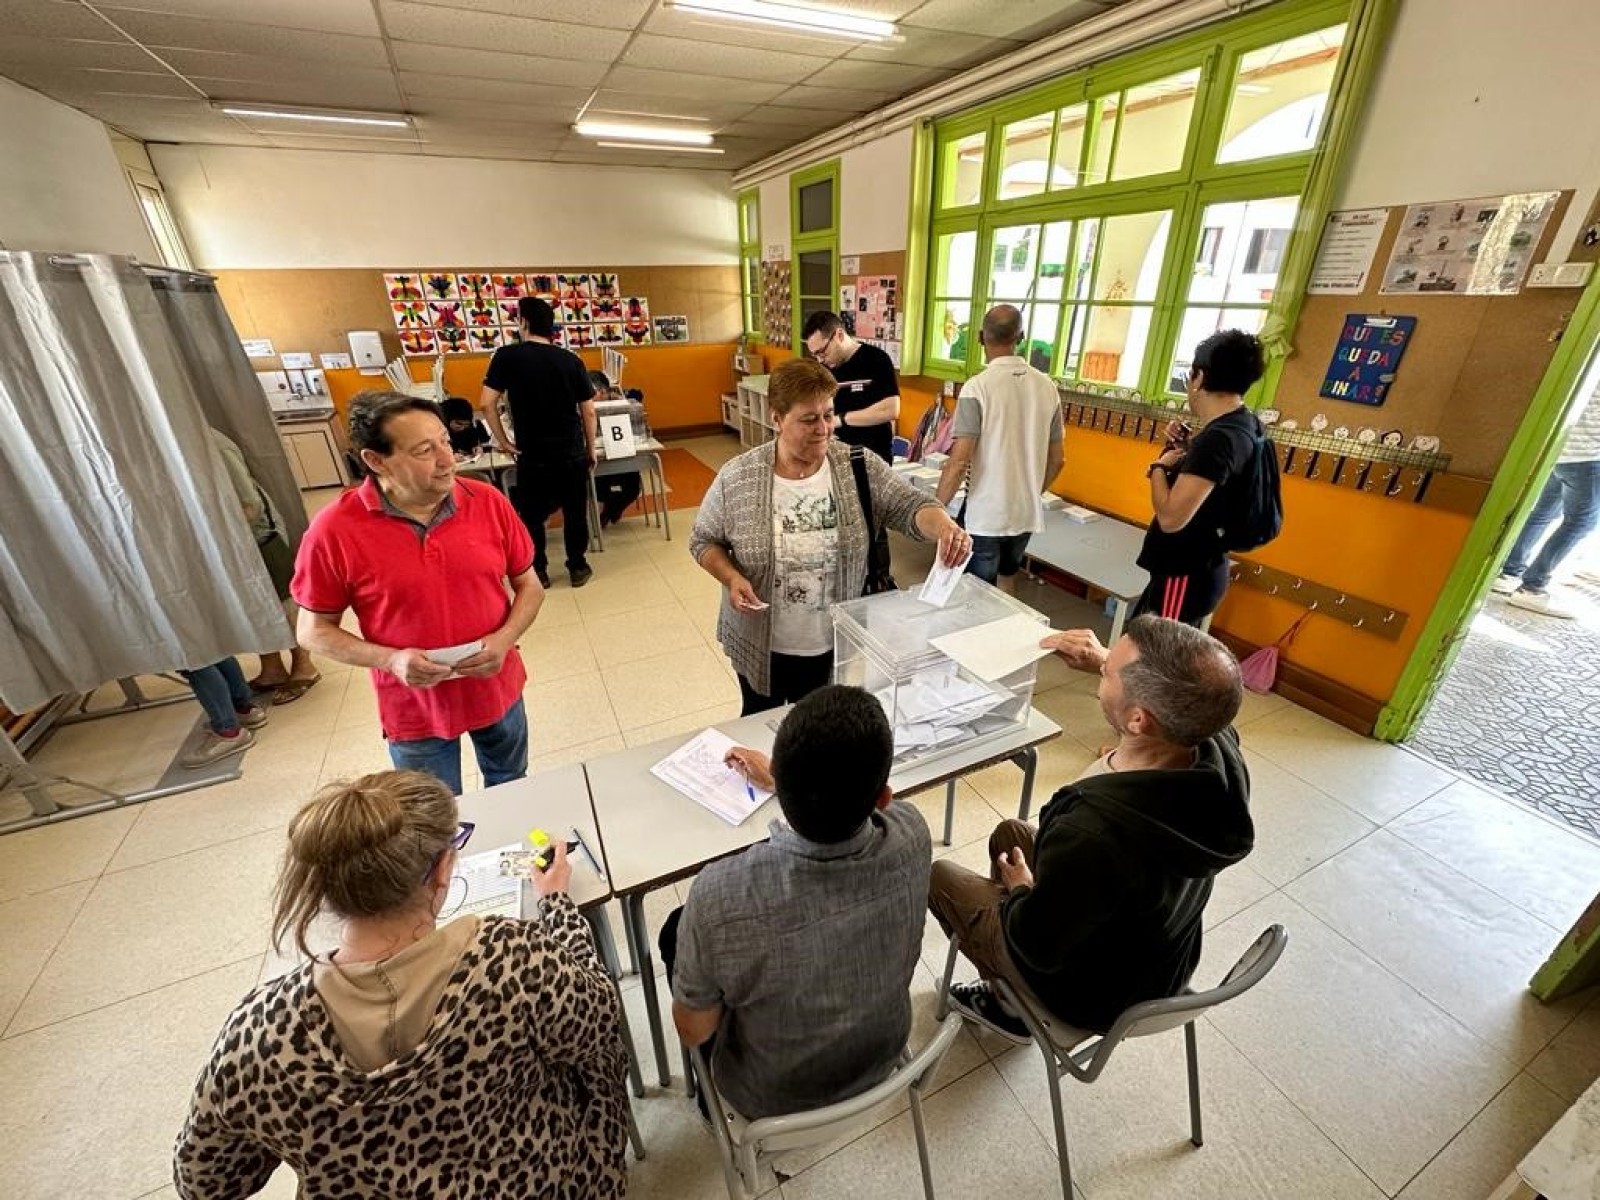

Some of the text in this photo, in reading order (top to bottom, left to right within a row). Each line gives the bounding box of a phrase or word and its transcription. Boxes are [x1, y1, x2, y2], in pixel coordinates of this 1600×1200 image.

[1381, 329, 1405, 346] ES
[1338, 347, 1389, 366] QUEDA
[1348, 366, 1361, 381] A
[612, 426, 624, 441] B
